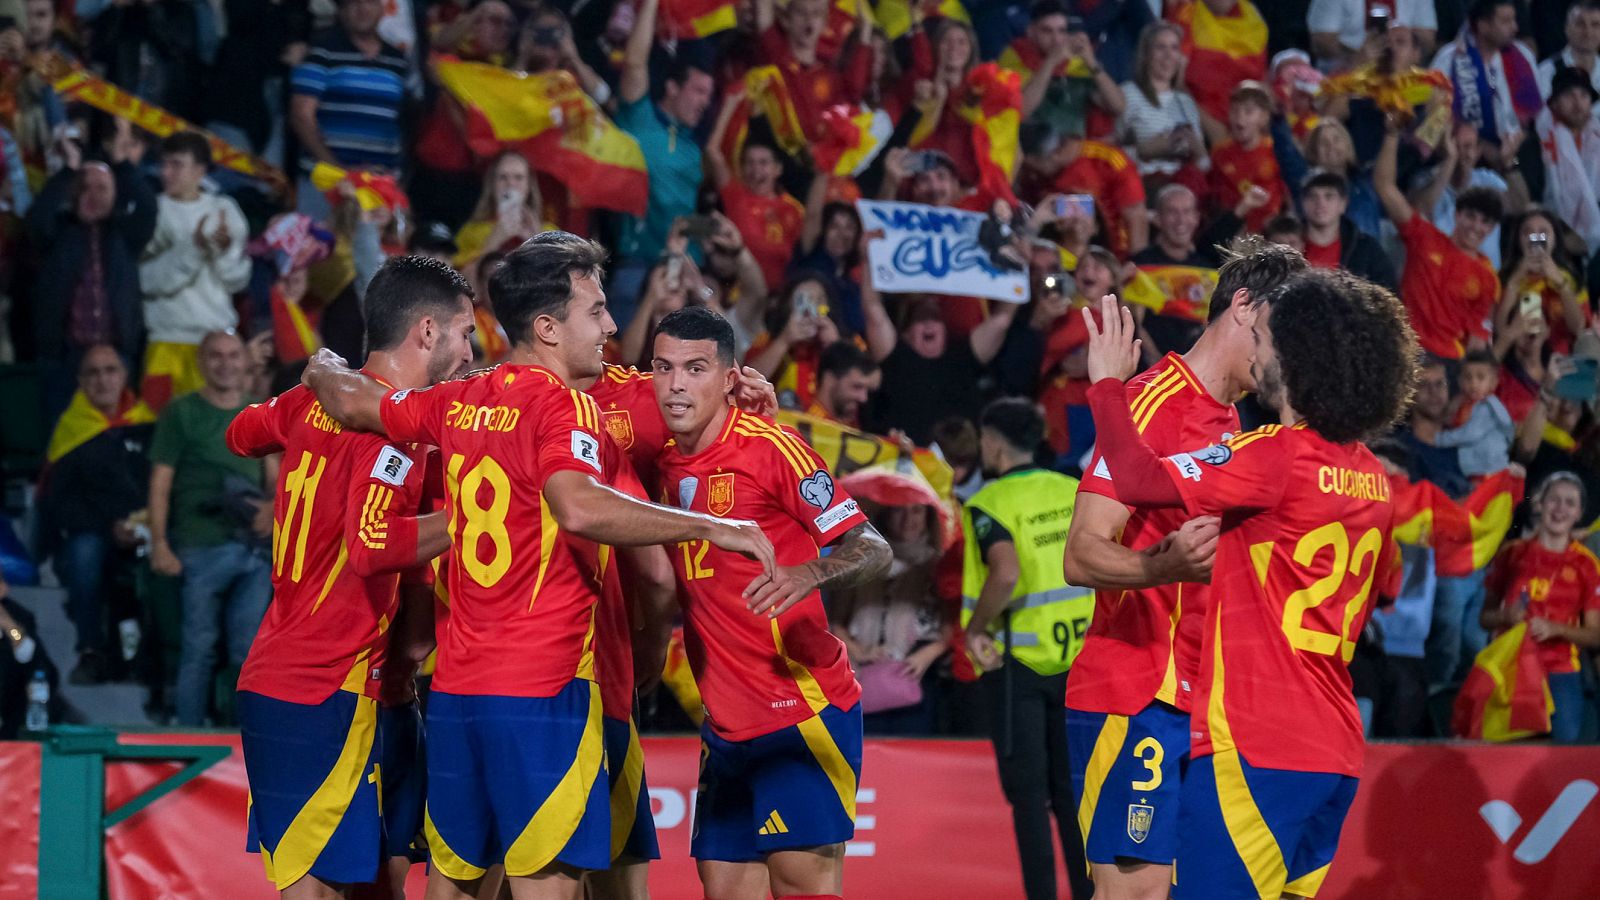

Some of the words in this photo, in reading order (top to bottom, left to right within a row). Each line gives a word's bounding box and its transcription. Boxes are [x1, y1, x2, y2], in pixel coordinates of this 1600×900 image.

[277, 450, 327, 583] 11
[446, 453, 512, 588] 18
[677, 539, 714, 580] 12
[1281, 521, 1382, 663] 22
[1131, 736, 1165, 791] 3
